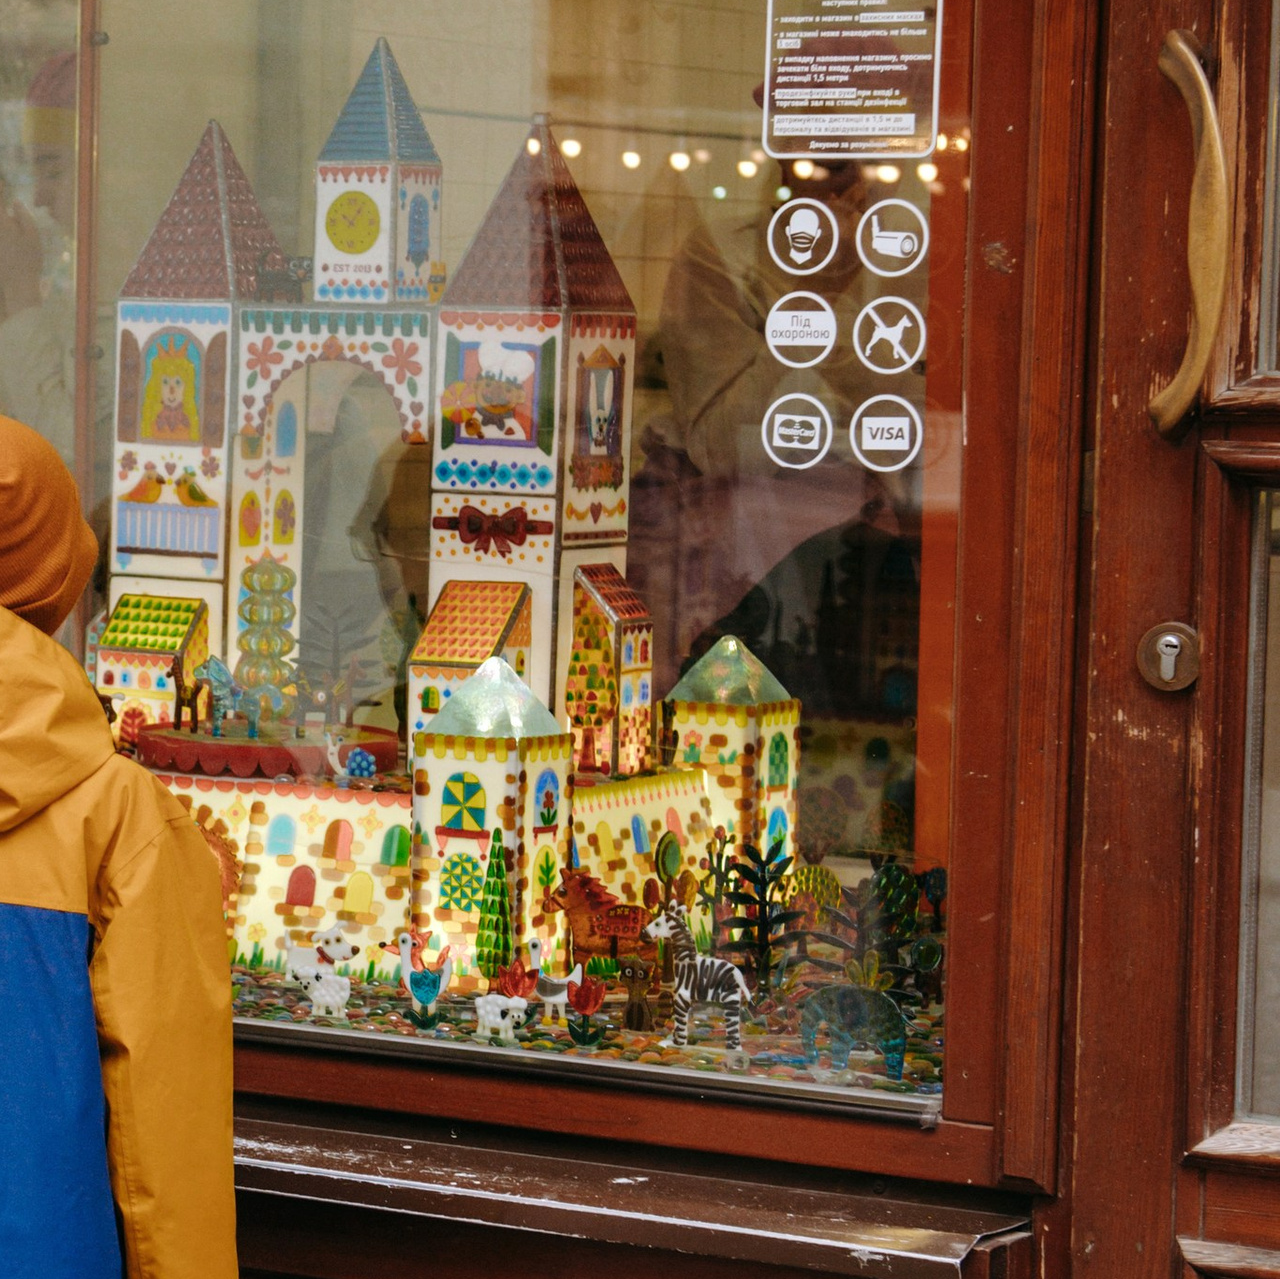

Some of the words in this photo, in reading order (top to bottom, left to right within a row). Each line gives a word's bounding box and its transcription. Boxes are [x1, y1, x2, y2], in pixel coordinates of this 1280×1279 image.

[813, 74, 824, 82] 1,5
[333, 264, 350, 272] EST
[353, 264, 373, 273] 2013
[791, 315, 811, 328] Під
[771, 328, 830, 342] охороною
[867, 427, 905, 440] VISA
